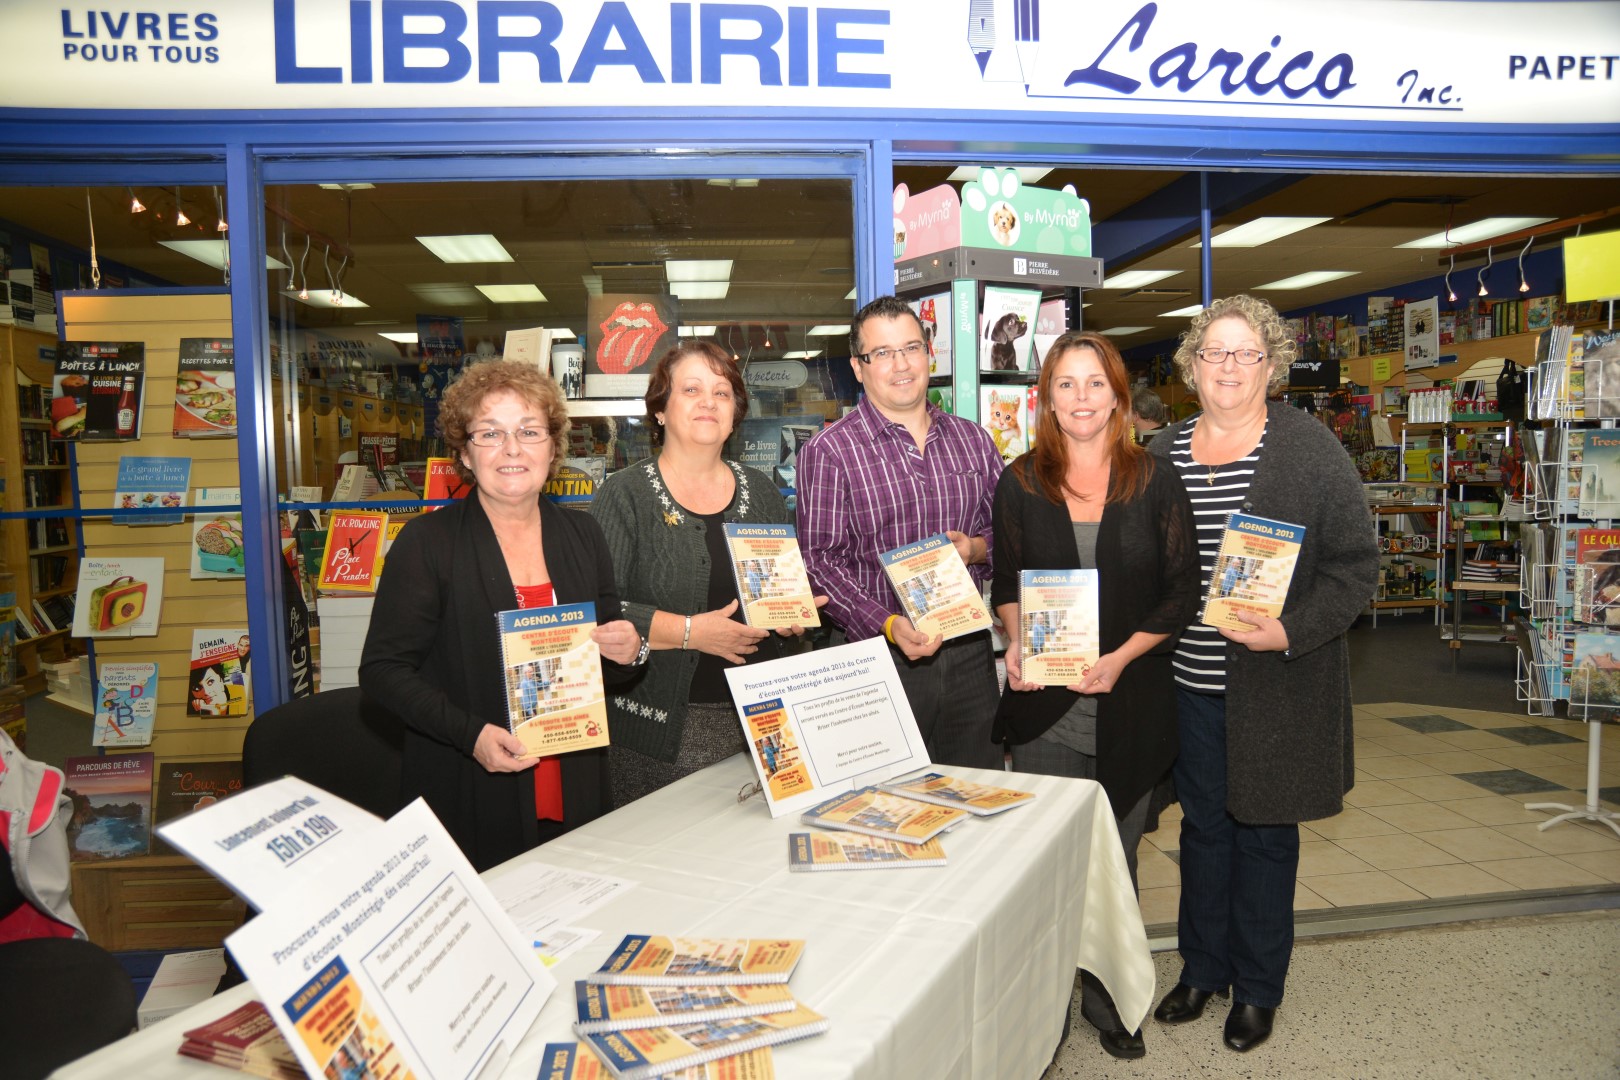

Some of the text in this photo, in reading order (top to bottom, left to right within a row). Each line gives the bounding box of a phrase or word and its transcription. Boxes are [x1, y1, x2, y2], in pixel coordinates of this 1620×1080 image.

[60, 9, 219, 41] LIVRES
[273, 0, 891, 89] LIBRAIRIE
[63, 43, 220, 64] POUR TOUS
[1064, 2, 1462, 105] Larico Inc.
[909, 201, 952, 231] By Myrna
[1024, 207, 1080, 229] By Myrna
[899, 267, 915, 276] PIERRE
[1028, 260, 1049, 269] PIERRE
[960, 301, 971, 332] Myrna
[60, 360, 96, 370] BOÎTES
[109, 362, 140, 371] LUNCH
[92, 380, 122, 388] CUISINE
[361, 436, 380, 445] CHASSE
[744, 440, 777, 450] Le livre
[740, 452, 777, 462] dont tout
[335, 519, 380, 529] J.K. ROWLING
[1238, 521, 1295, 539] AGENDA 2013
[737, 528, 787, 536] AGENDA 2013
[1583, 535, 1596, 545] LE
[891, 539, 942, 561] AGENDA 2013
[90, 569, 123, 577] enfants
[333, 563, 370, 582] Prendre
[1032, 576, 1067, 584] AGENDA
[514, 610, 585, 628] AGENDA 2013
[522, 627, 579, 640] CENTRE D'ÉCOUTE
[199, 637, 227, 650] DEMAIN,
[199, 643, 237, 658] J'ENSEIGNE
[104, 675, 136, 684] parents
[744, 676, 789, 691] Procurez-vous
[790, 672, 807, 680] votre
[808, 666, 830, 677] agenda
[831, 662, 846, 671] 2013
[855, 656, 877, 665] Centre
[758, 688, 786, 699] d'écoute
[787, 680, 822, 692] Montérégie
[76, 759, 141, 771] PARCOURS DE RÊVE
[266, 814, 338, 862] 15h à 19h
[272, 908, 341, 966] Procurez-vous
[340, 890, 362, 910] votre
[361, 870, 386, 894] agenda
[604, 1034, 639, 1062] AGENDA
